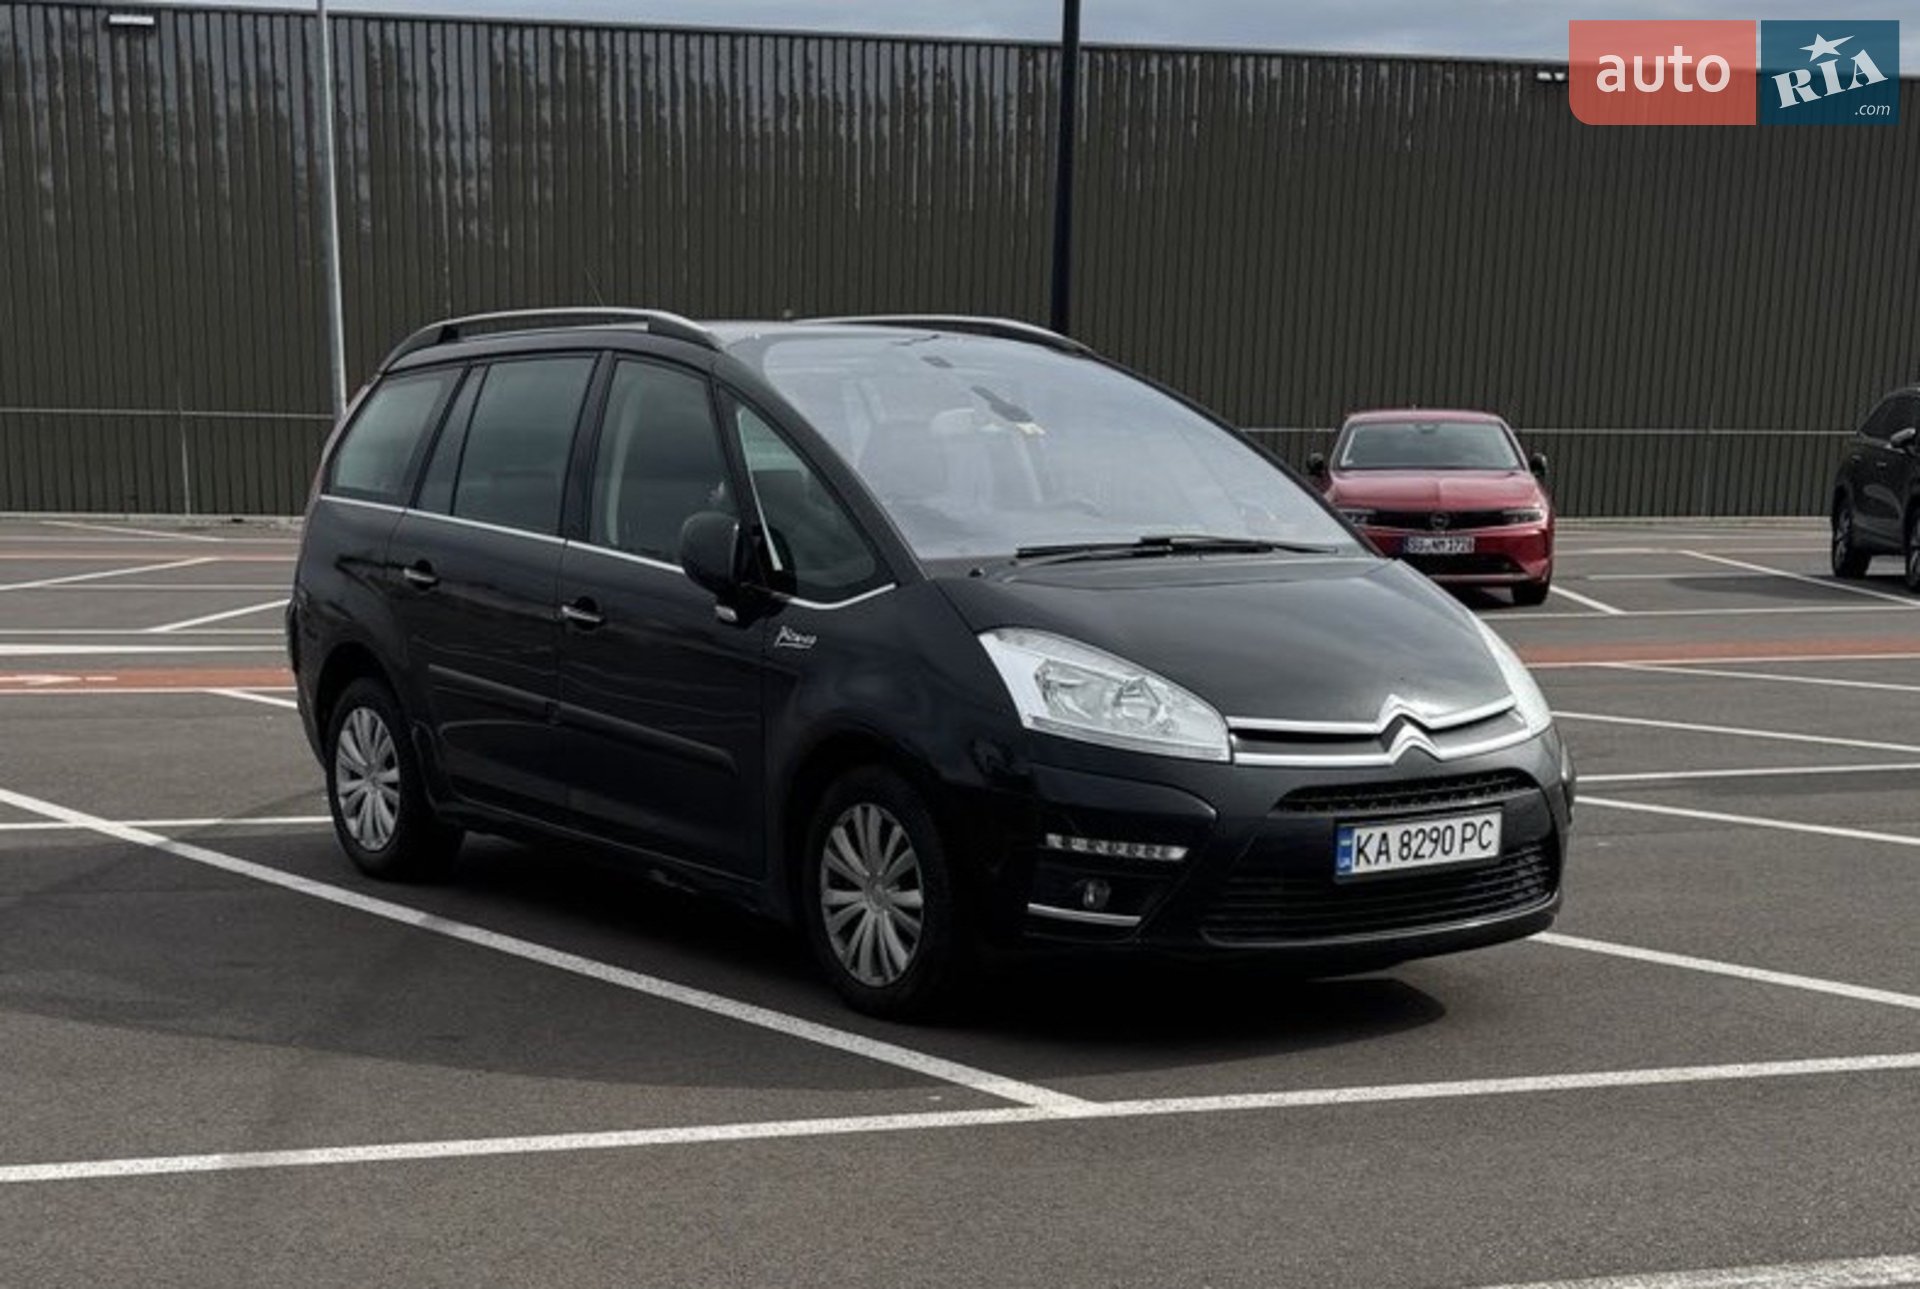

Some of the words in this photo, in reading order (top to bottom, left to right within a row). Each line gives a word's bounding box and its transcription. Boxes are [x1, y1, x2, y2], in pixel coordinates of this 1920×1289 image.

[1355, 832, 1391, 866] KA
[1399, 825, 1455, 861] 8290
[1460, 819, 1493, 854] PC
